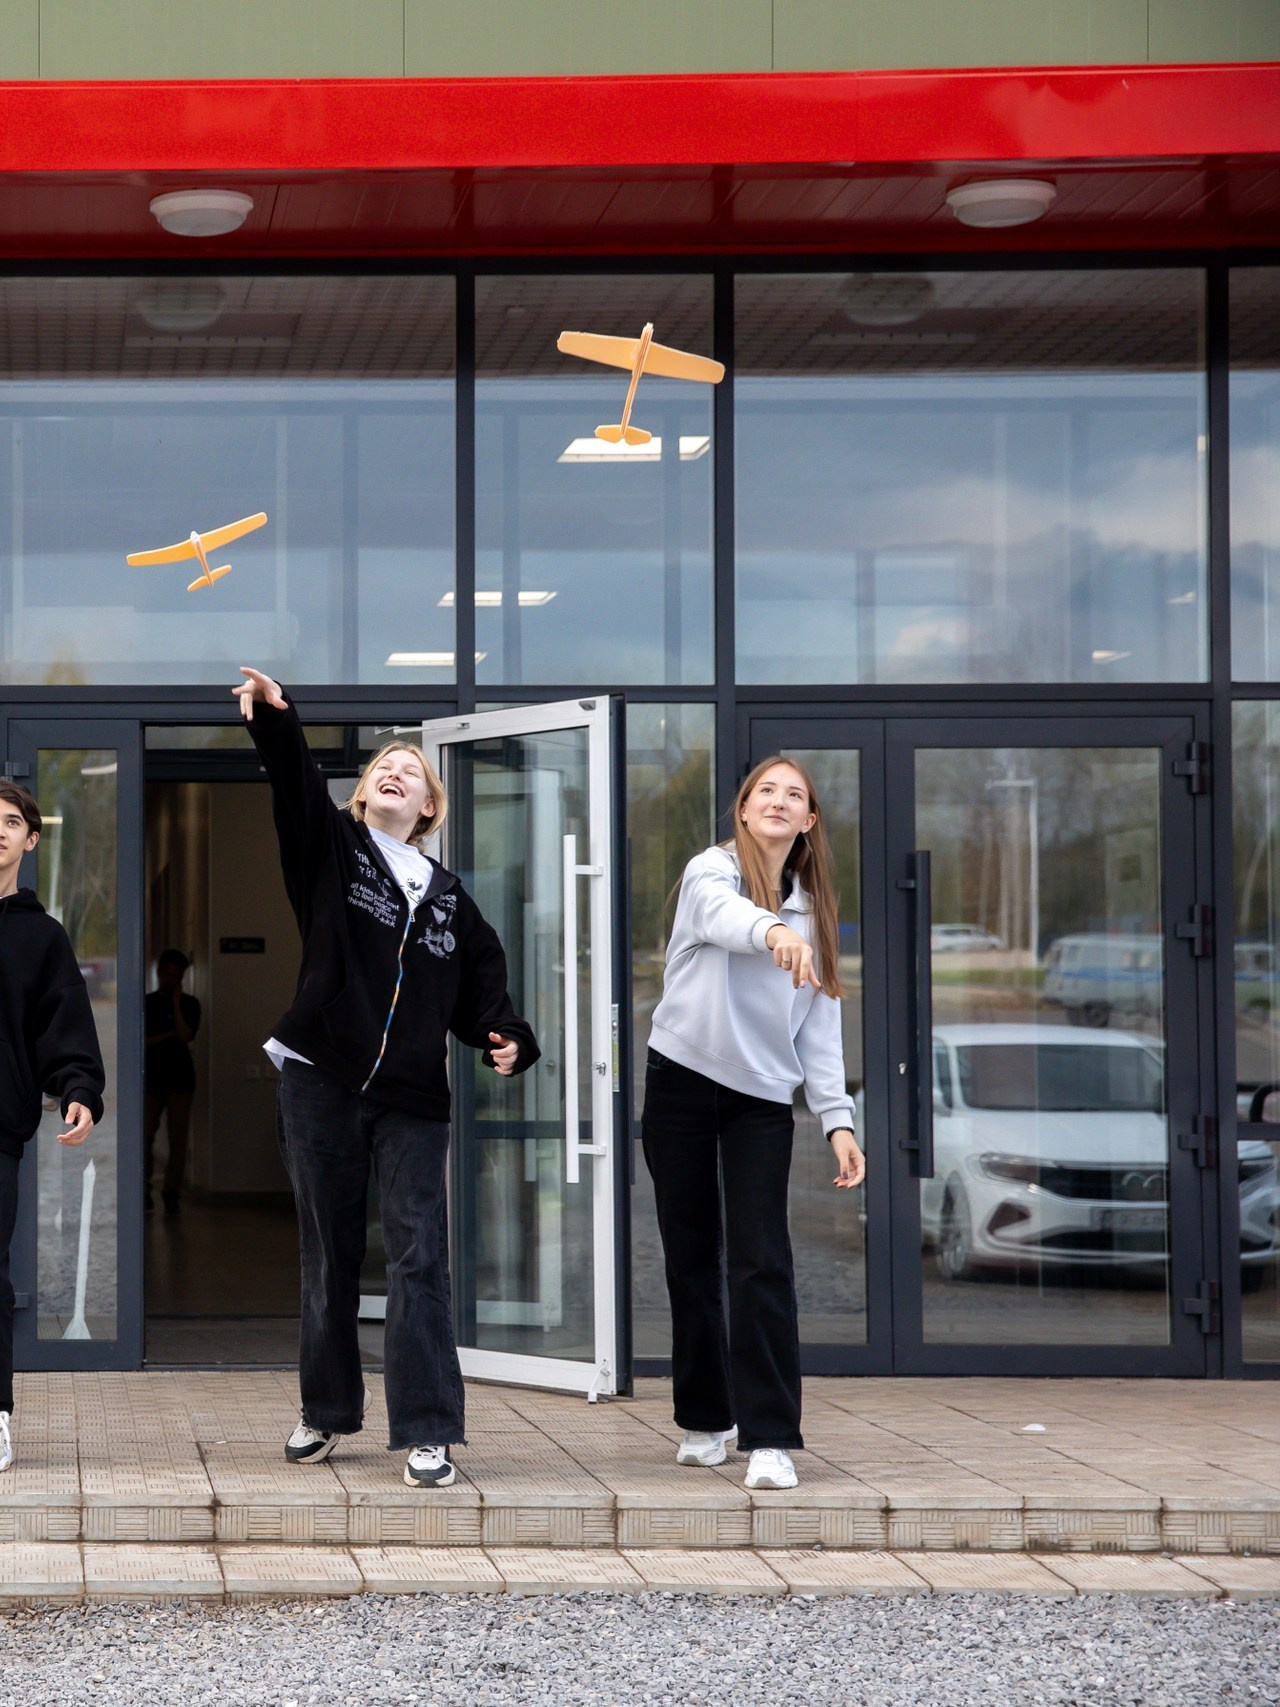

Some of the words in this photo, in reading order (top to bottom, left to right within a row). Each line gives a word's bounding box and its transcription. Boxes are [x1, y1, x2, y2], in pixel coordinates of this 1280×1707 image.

[353, 889, 360, 897] to
[359, 884, 374, 896] kids
[347, 896, 374, 914] thinking
